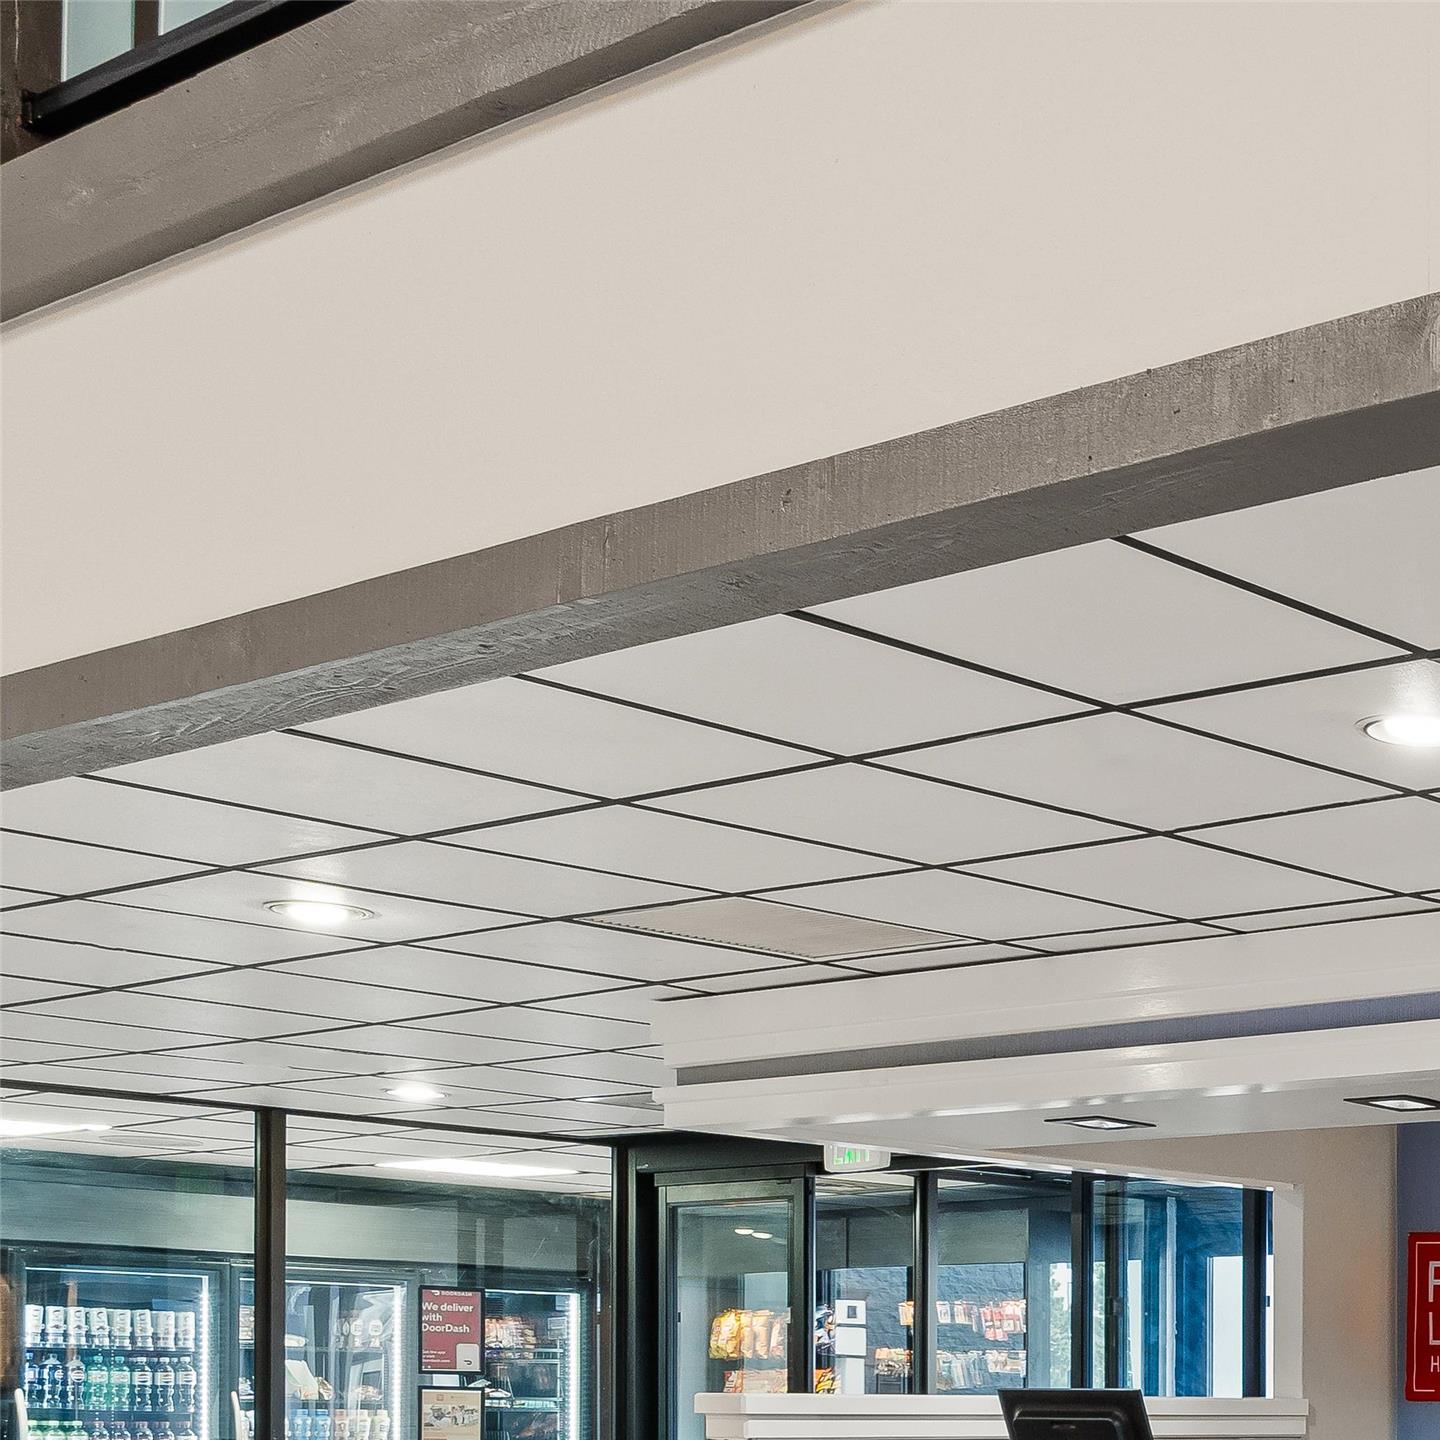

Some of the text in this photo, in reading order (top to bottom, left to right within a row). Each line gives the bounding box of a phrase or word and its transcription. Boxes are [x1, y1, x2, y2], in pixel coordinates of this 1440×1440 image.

[422, 1302, 474, 1312] We deliver
[422, 1323, 470, 1333] DoorDash
